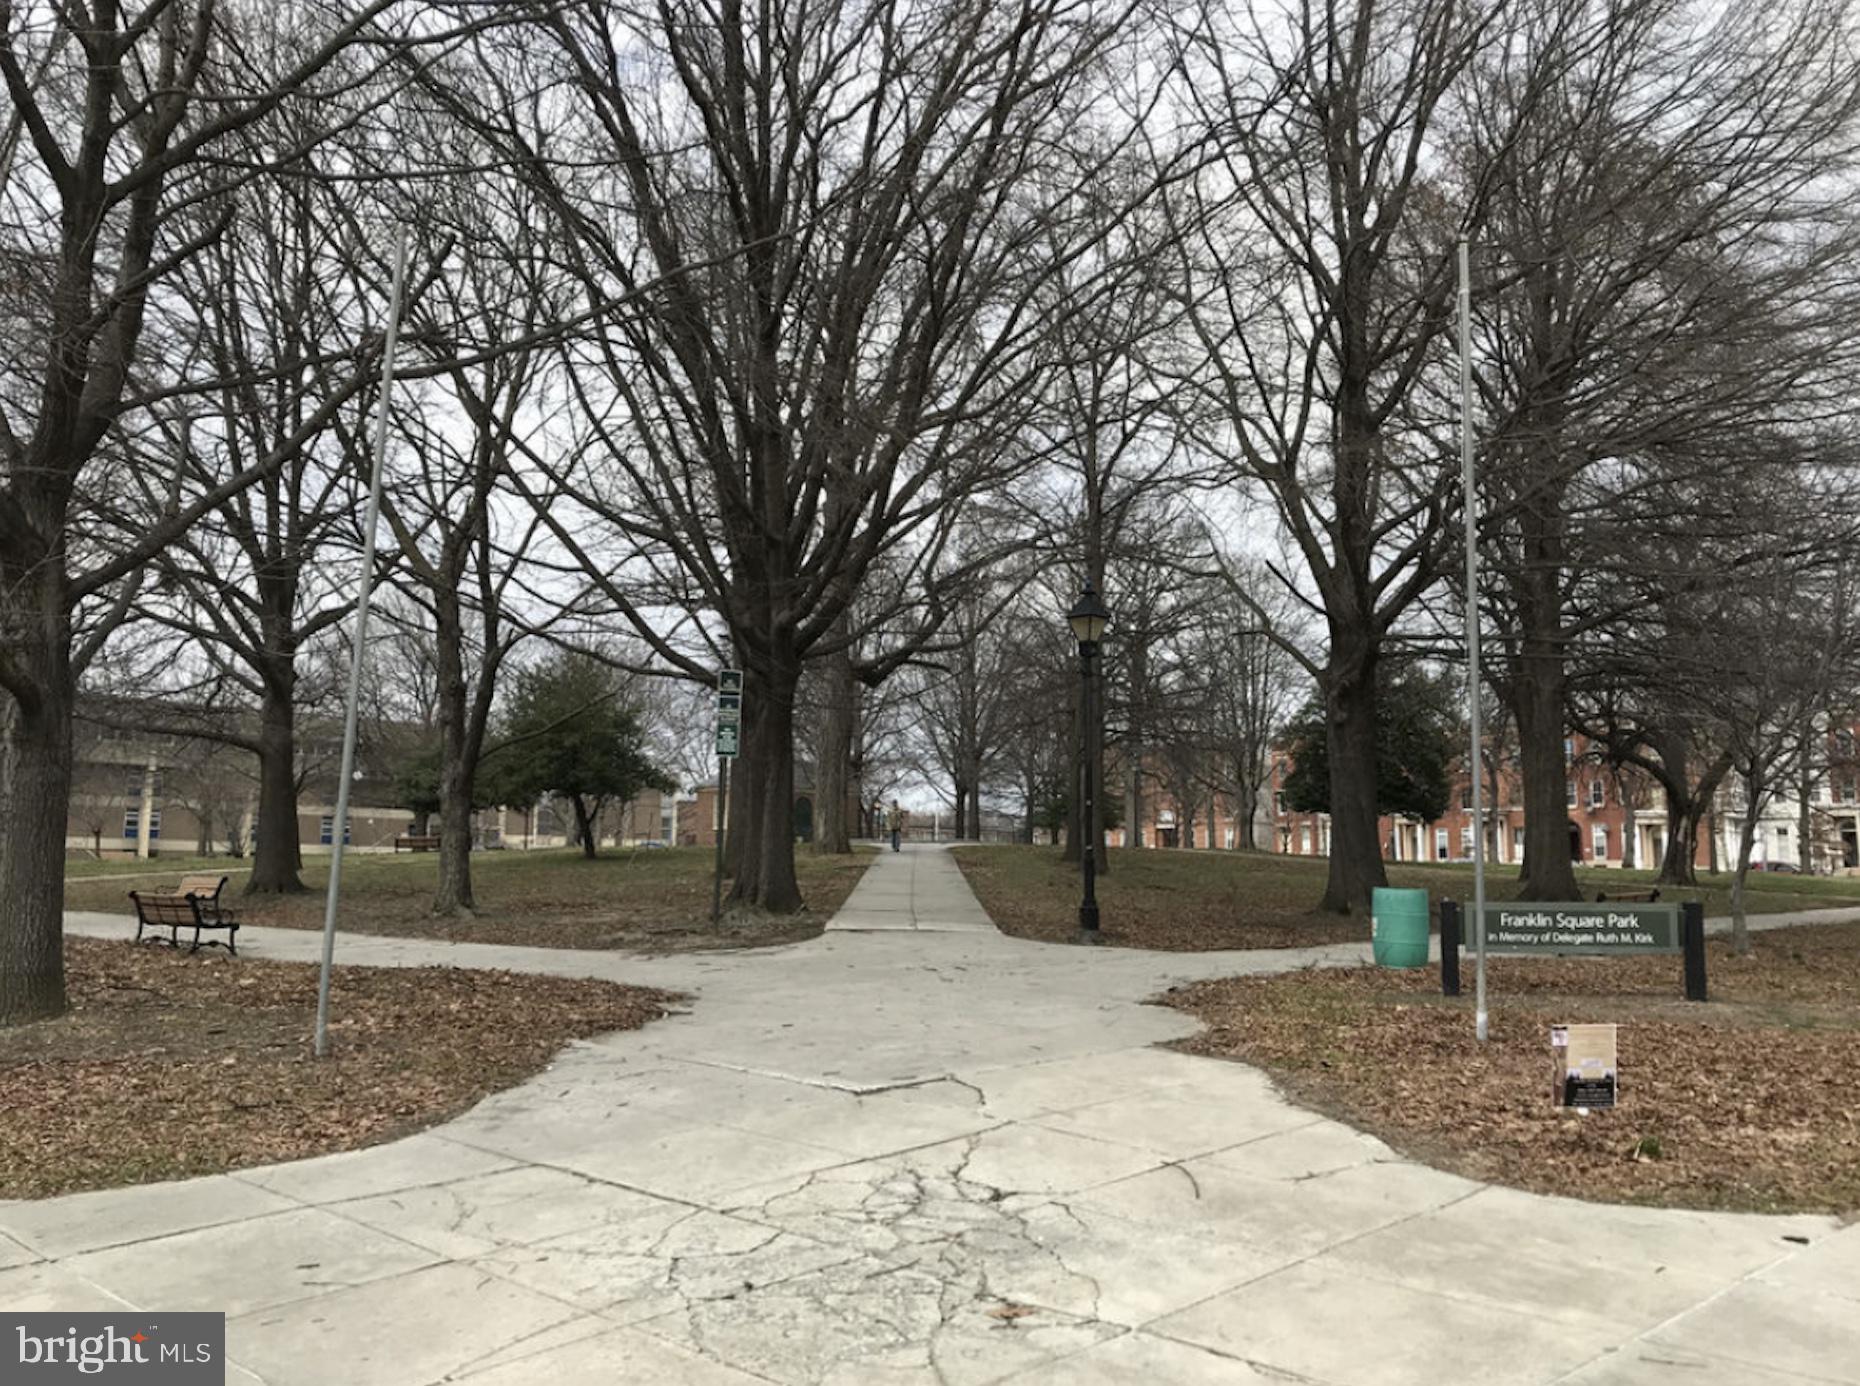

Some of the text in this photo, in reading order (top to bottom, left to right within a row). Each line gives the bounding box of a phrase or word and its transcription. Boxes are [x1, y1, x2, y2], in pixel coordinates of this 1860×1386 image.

[1501, 912, 1640, 930] Franklin Square Park
[1499, 931, 1538, 945] Memory
[1541, 932, 1551, 943] of
[1552, 932, 1594, 945] Delegate
[1596, 932, 1619, 943] Ruth
[1635, 933, 1654, 943] Kirk
